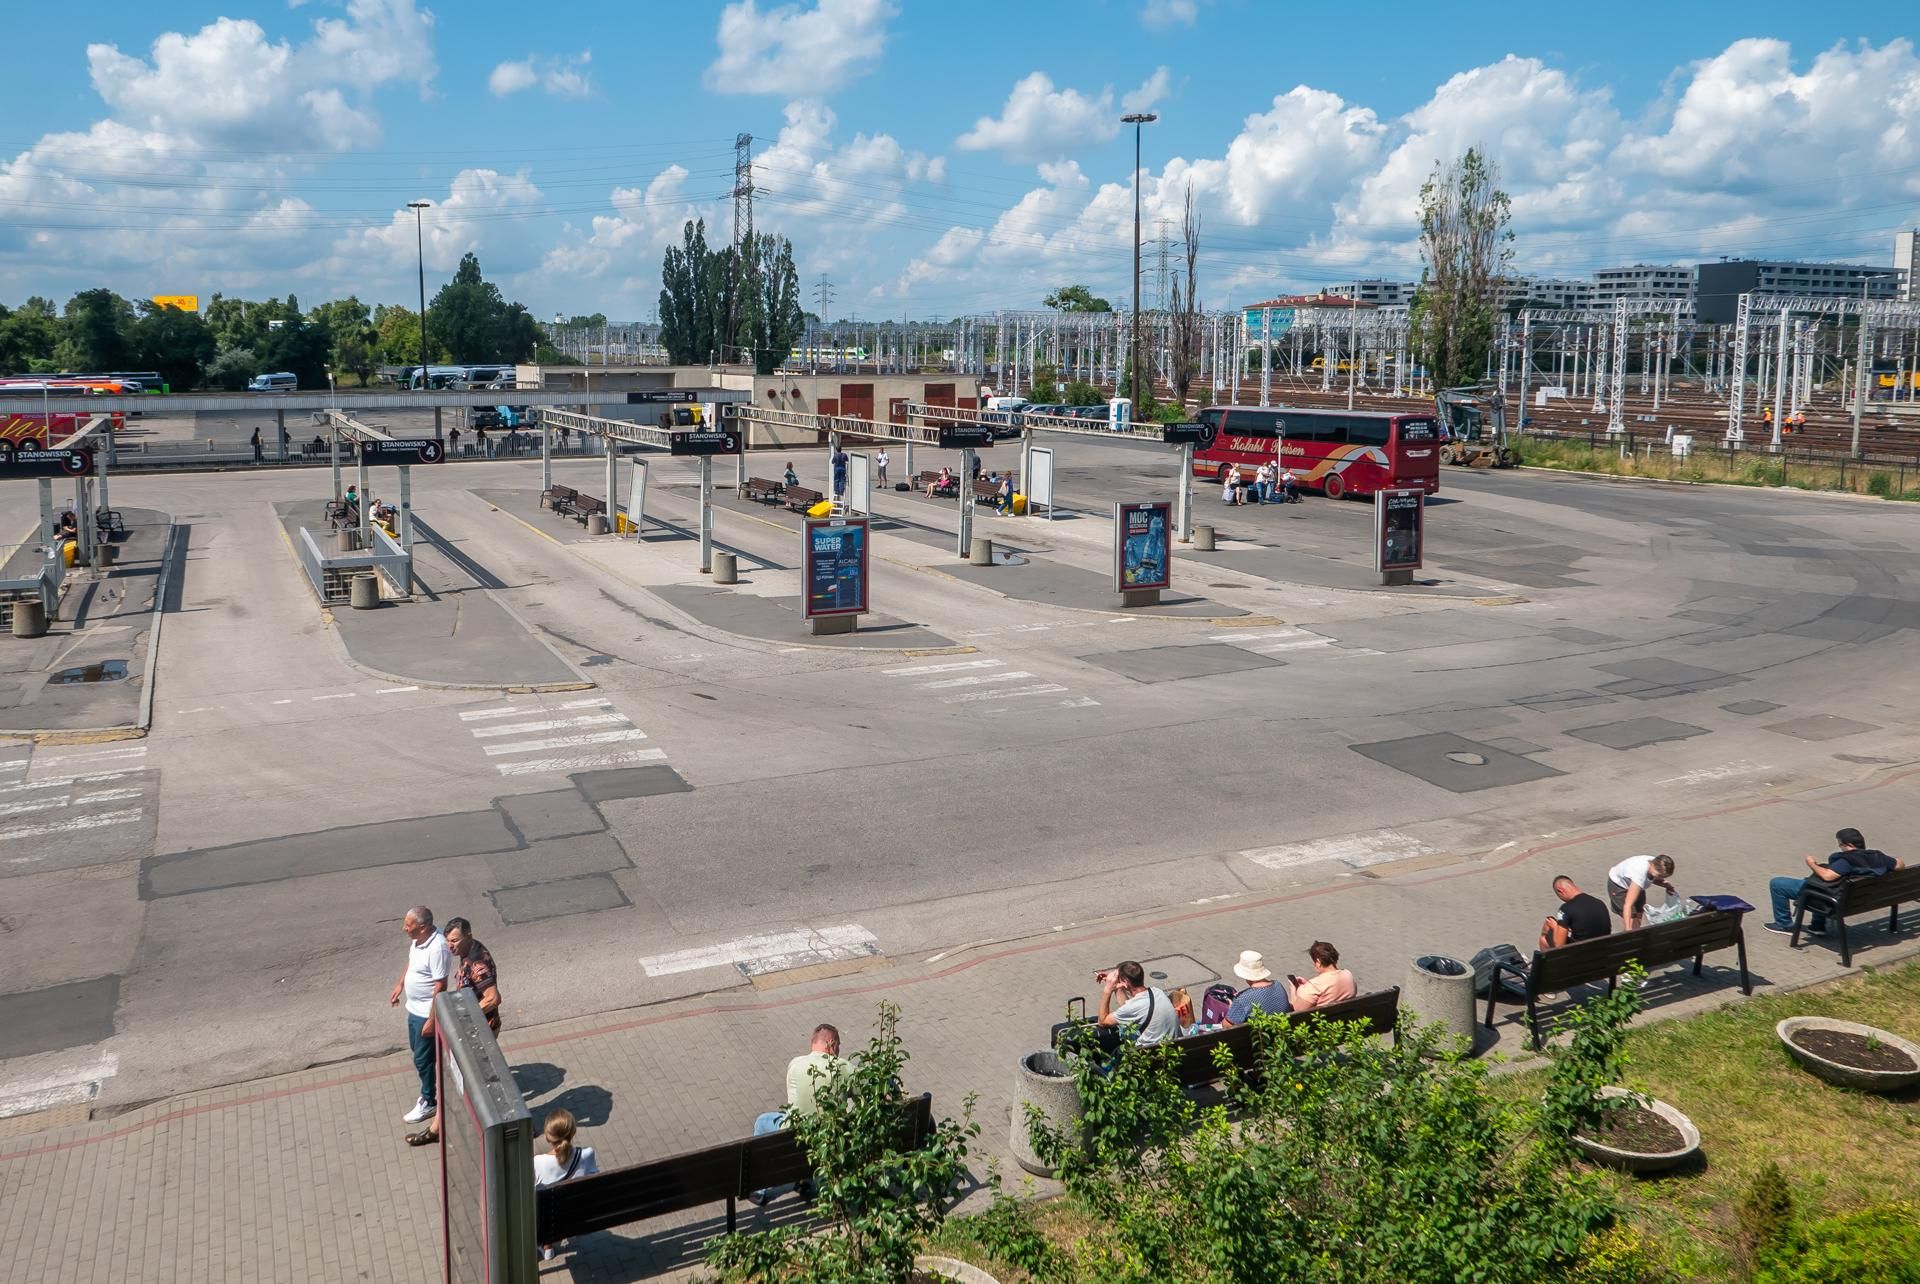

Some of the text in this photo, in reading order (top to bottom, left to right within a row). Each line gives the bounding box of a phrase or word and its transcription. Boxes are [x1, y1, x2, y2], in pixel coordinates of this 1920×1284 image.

[986, 432, 993, 442] 2
[1204, 428, 1208, 437] 1
[726, 438, 734, 448] 3
[1270, 440, 1305, 456] Reisen
[18, 450, 71, 458] STANOWISKO
[426, 445, 435, 457] 4
[71, 456, 82, 468] 5
[1129, 511, 1148, 524] MOC
